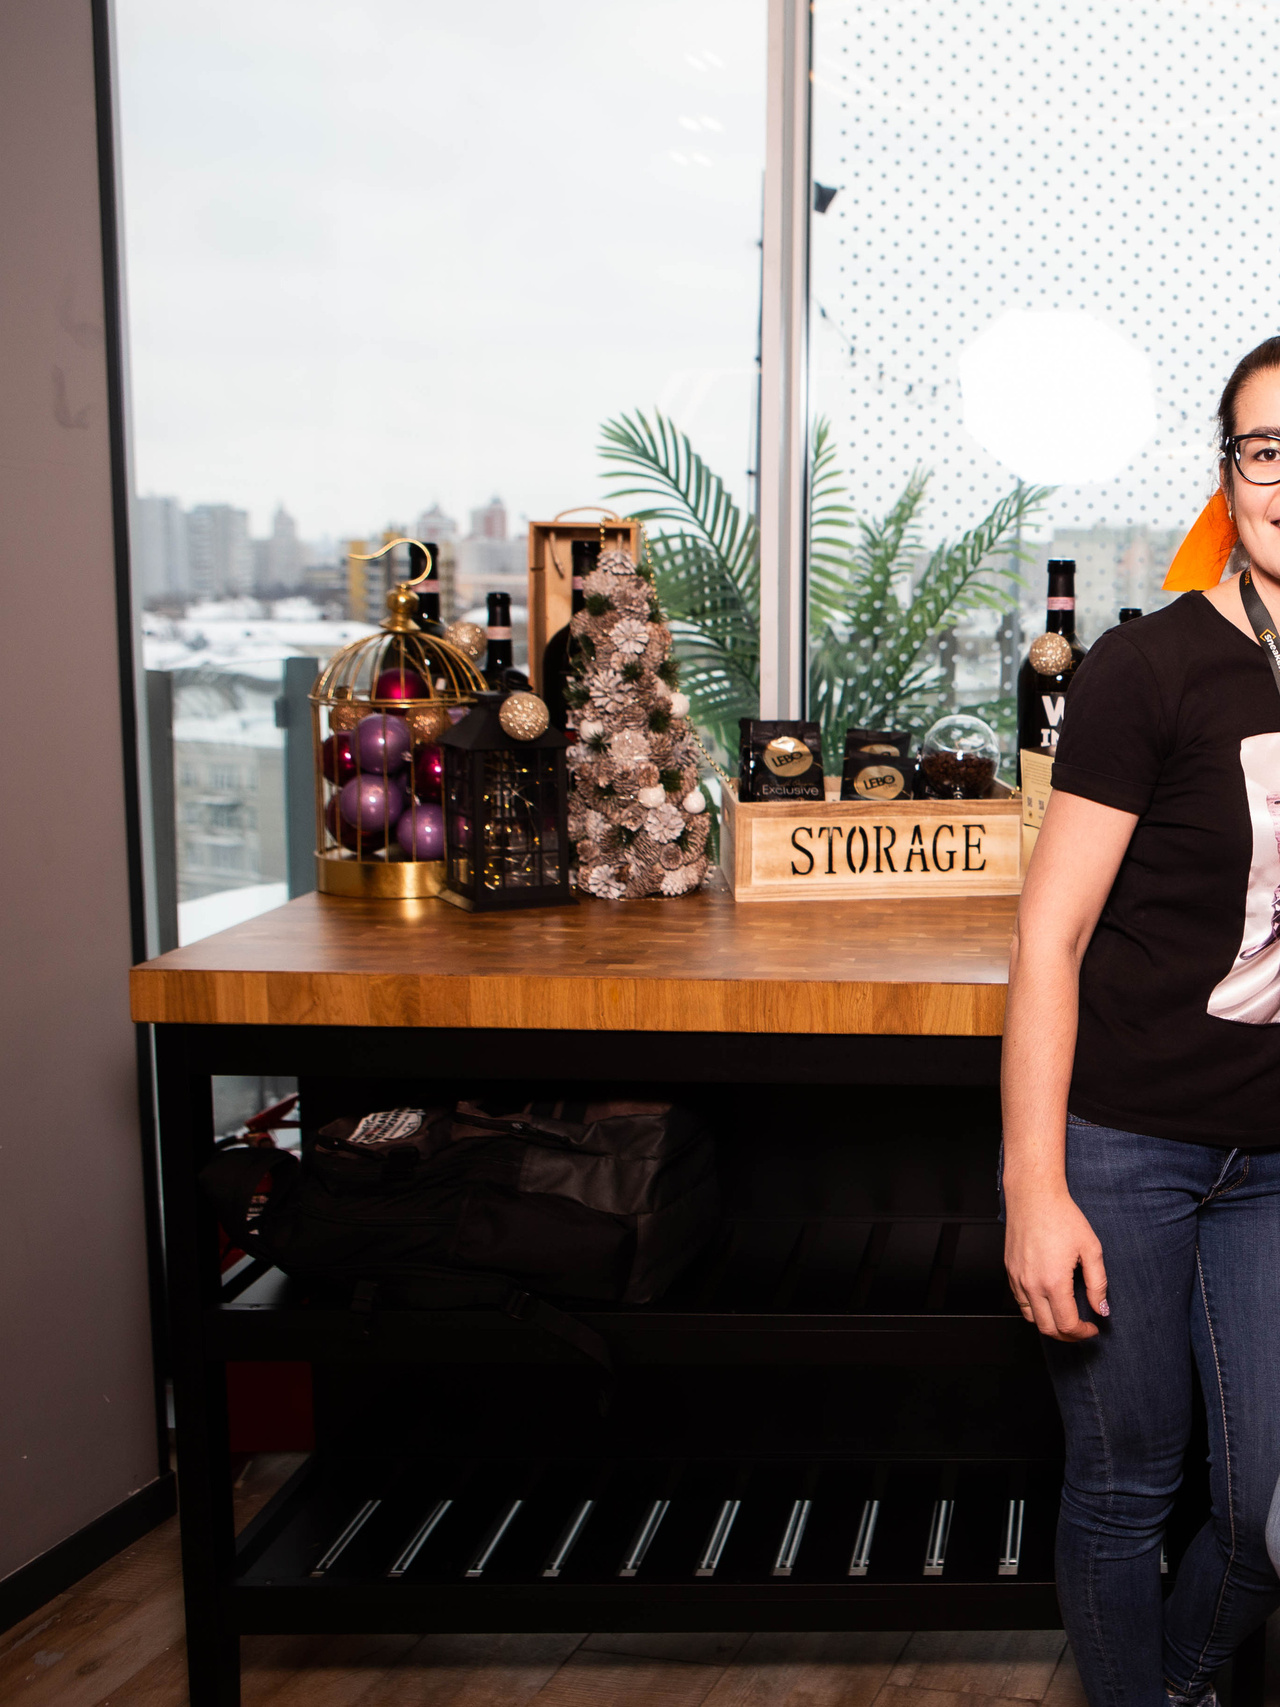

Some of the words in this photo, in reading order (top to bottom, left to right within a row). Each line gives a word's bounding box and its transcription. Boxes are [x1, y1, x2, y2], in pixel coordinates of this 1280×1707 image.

[762, 784, 820, 796] Exclusive
[863, 774, 896, 790] LEBO
[791, 824, 987, 876] STORAGE
